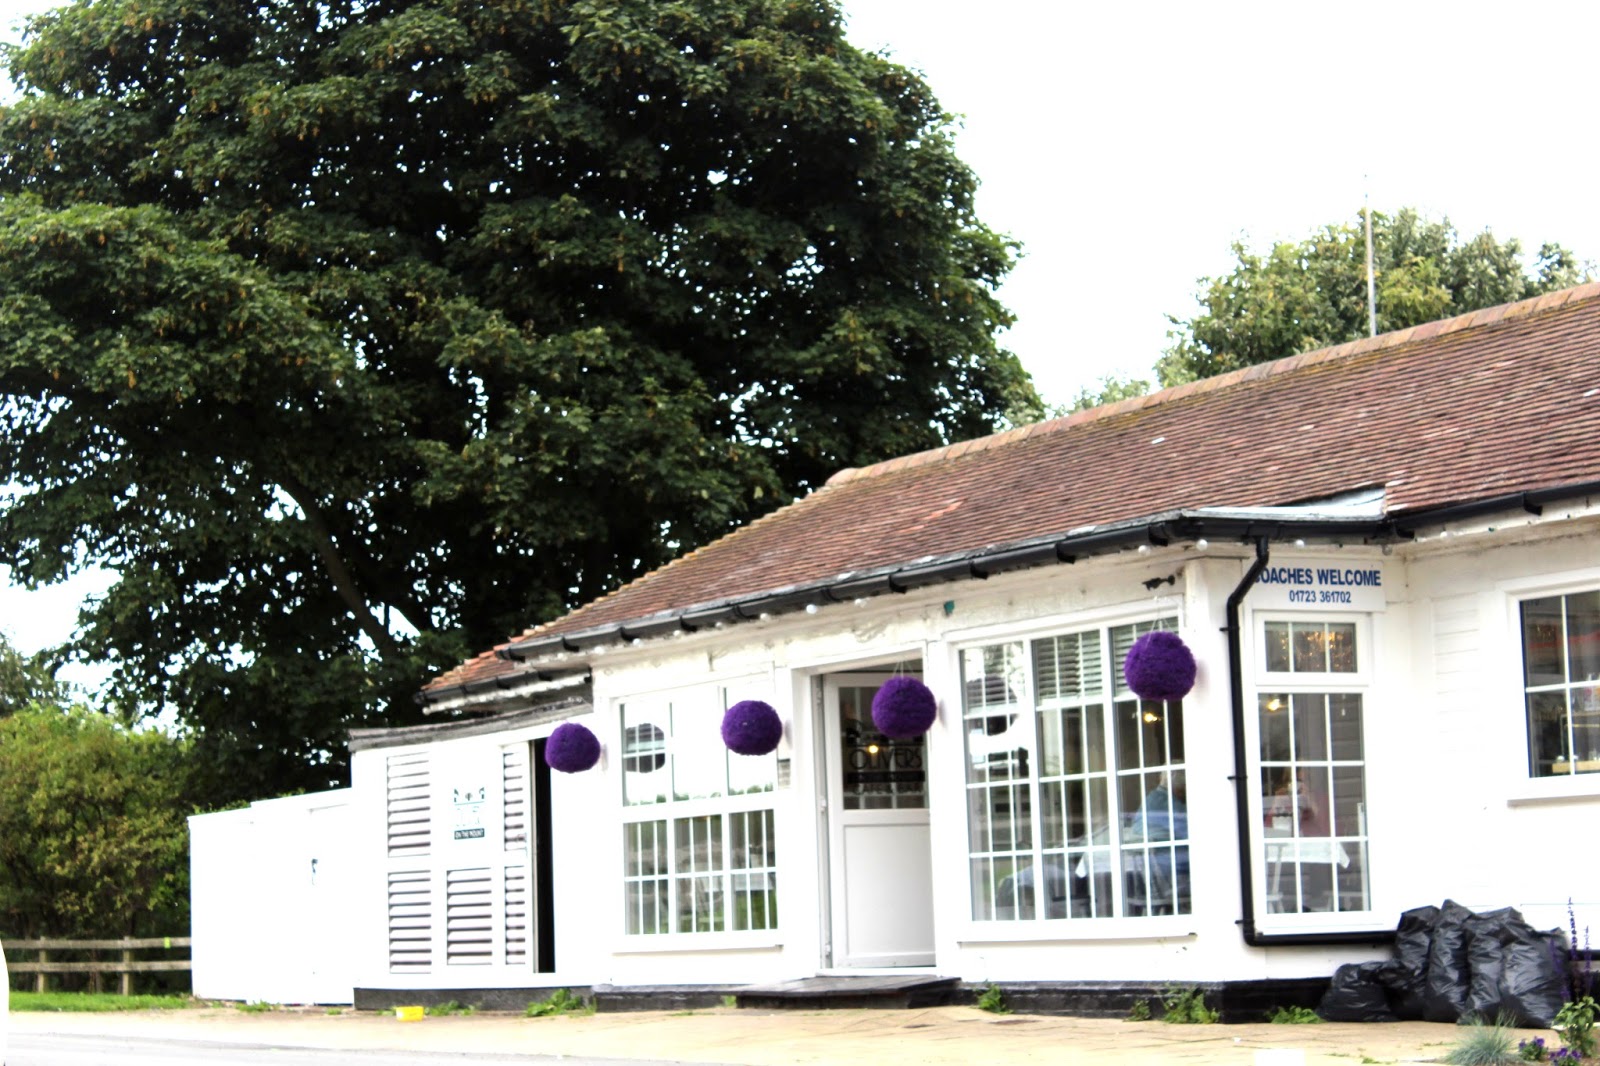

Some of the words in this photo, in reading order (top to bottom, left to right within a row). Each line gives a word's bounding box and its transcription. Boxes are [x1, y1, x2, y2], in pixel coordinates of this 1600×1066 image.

[1254, 567, 1313, 584] OACHES
[1317, 569, 1381, 586] WELCOME
[1289, 590, 1316, 603] 01723
[1320, 591, 1351, 603] 361702
